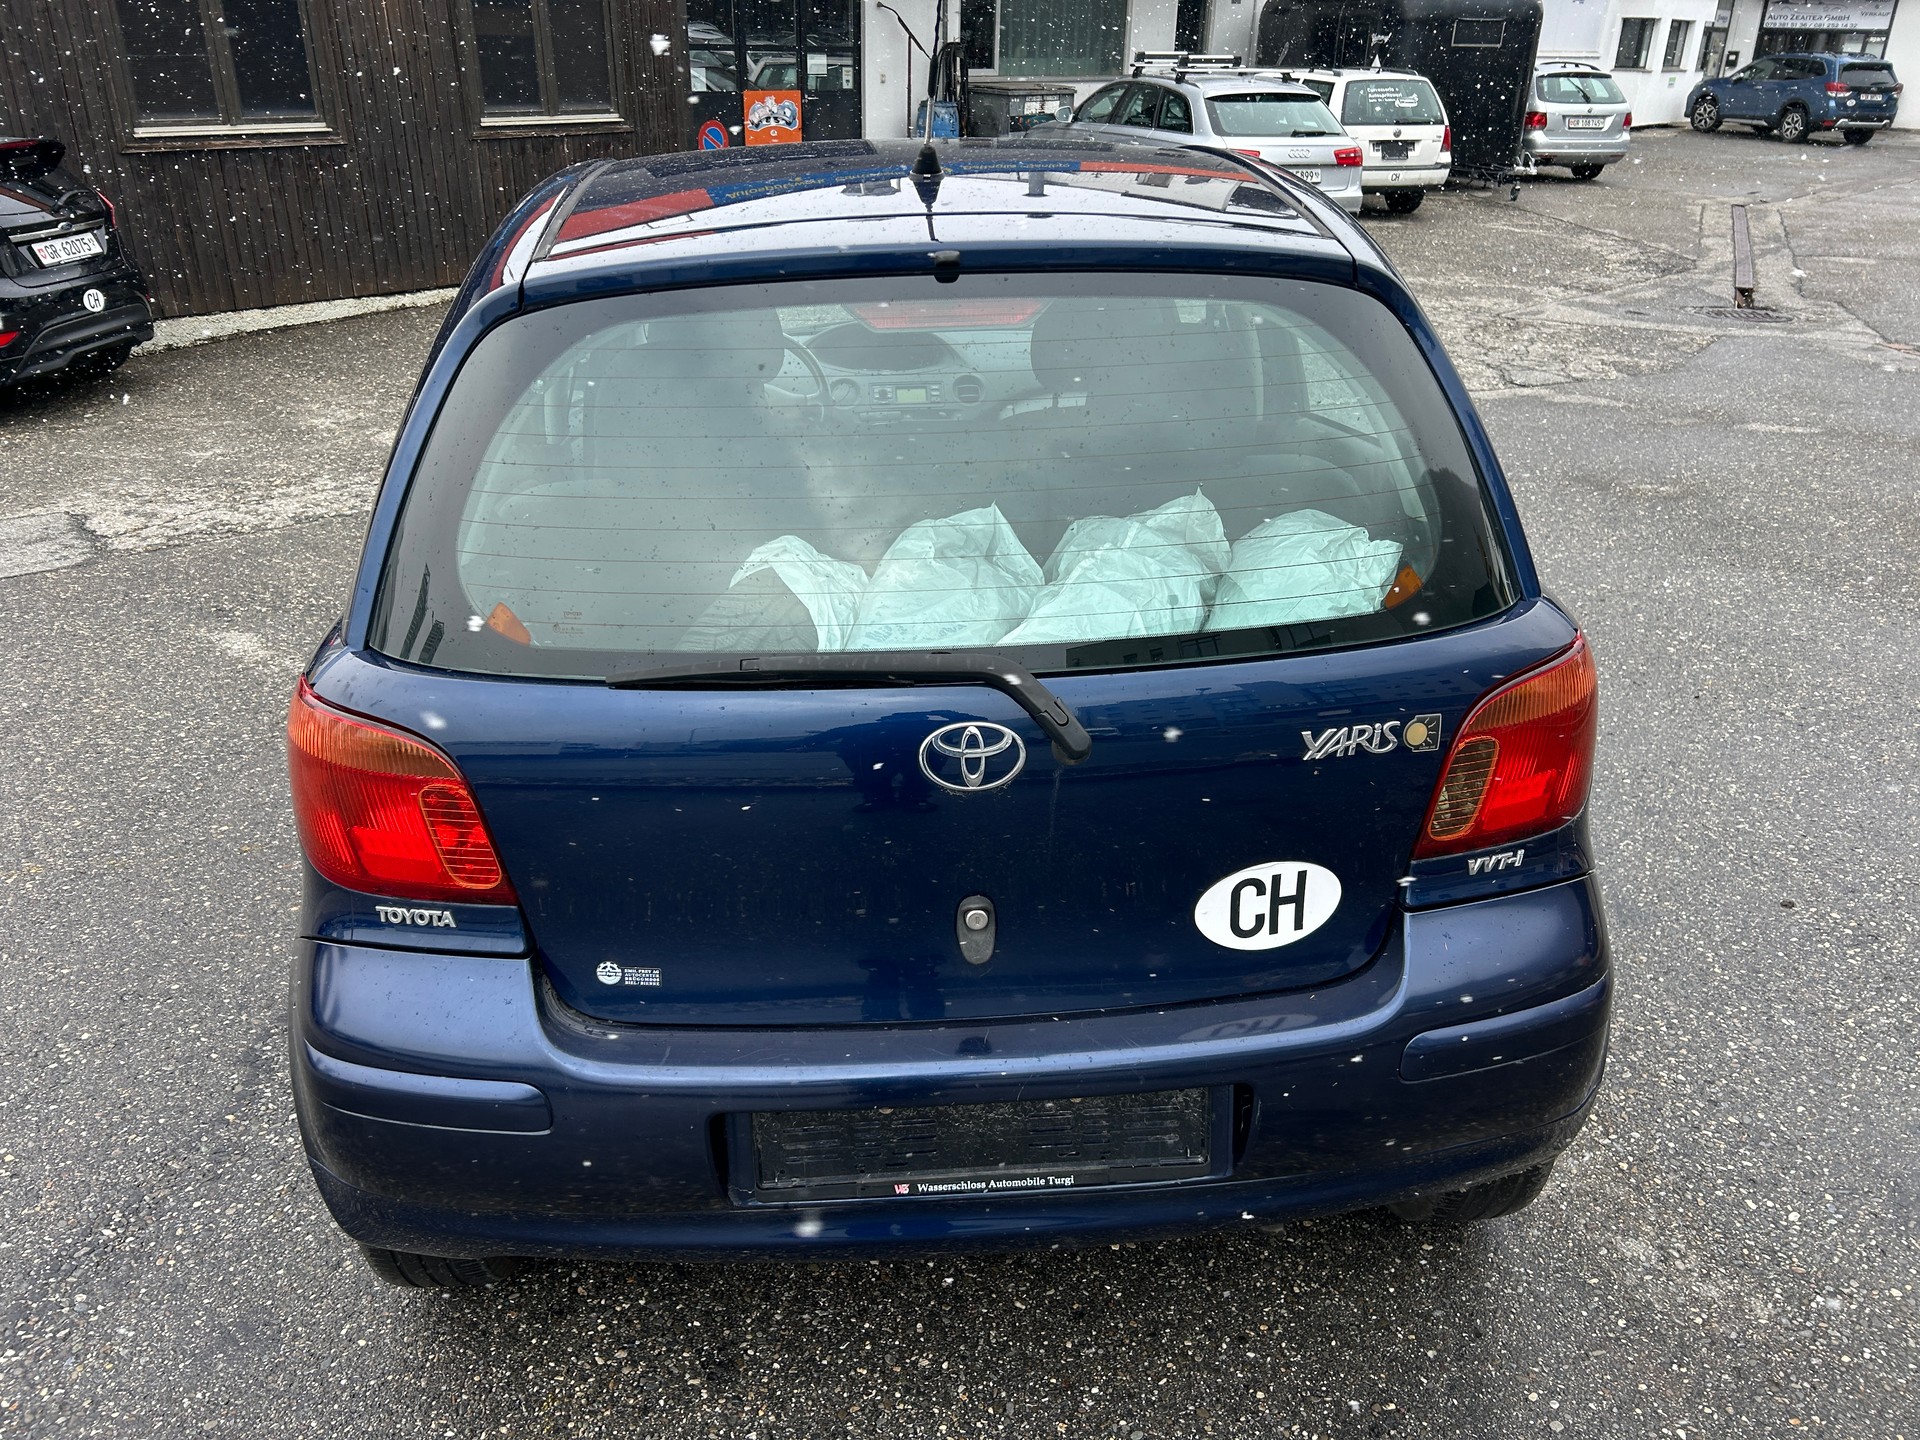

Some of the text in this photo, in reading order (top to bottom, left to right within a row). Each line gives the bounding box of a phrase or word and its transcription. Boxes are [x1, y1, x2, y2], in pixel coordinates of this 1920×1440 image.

[1391, 173, 1401, 182] CH
[44, 237, 91, 260] GR 62075
[87, 292, 101, 309] CH
[1230, 869, 1308, 939] CH
[375, 905, 457, 928] TOYOTA
[917, 1181, 986, 1193] Wasserschloss
[988, 1175, 1046, 1188] Automobile
[1047, 1174, 1075, 1186] Turgi
